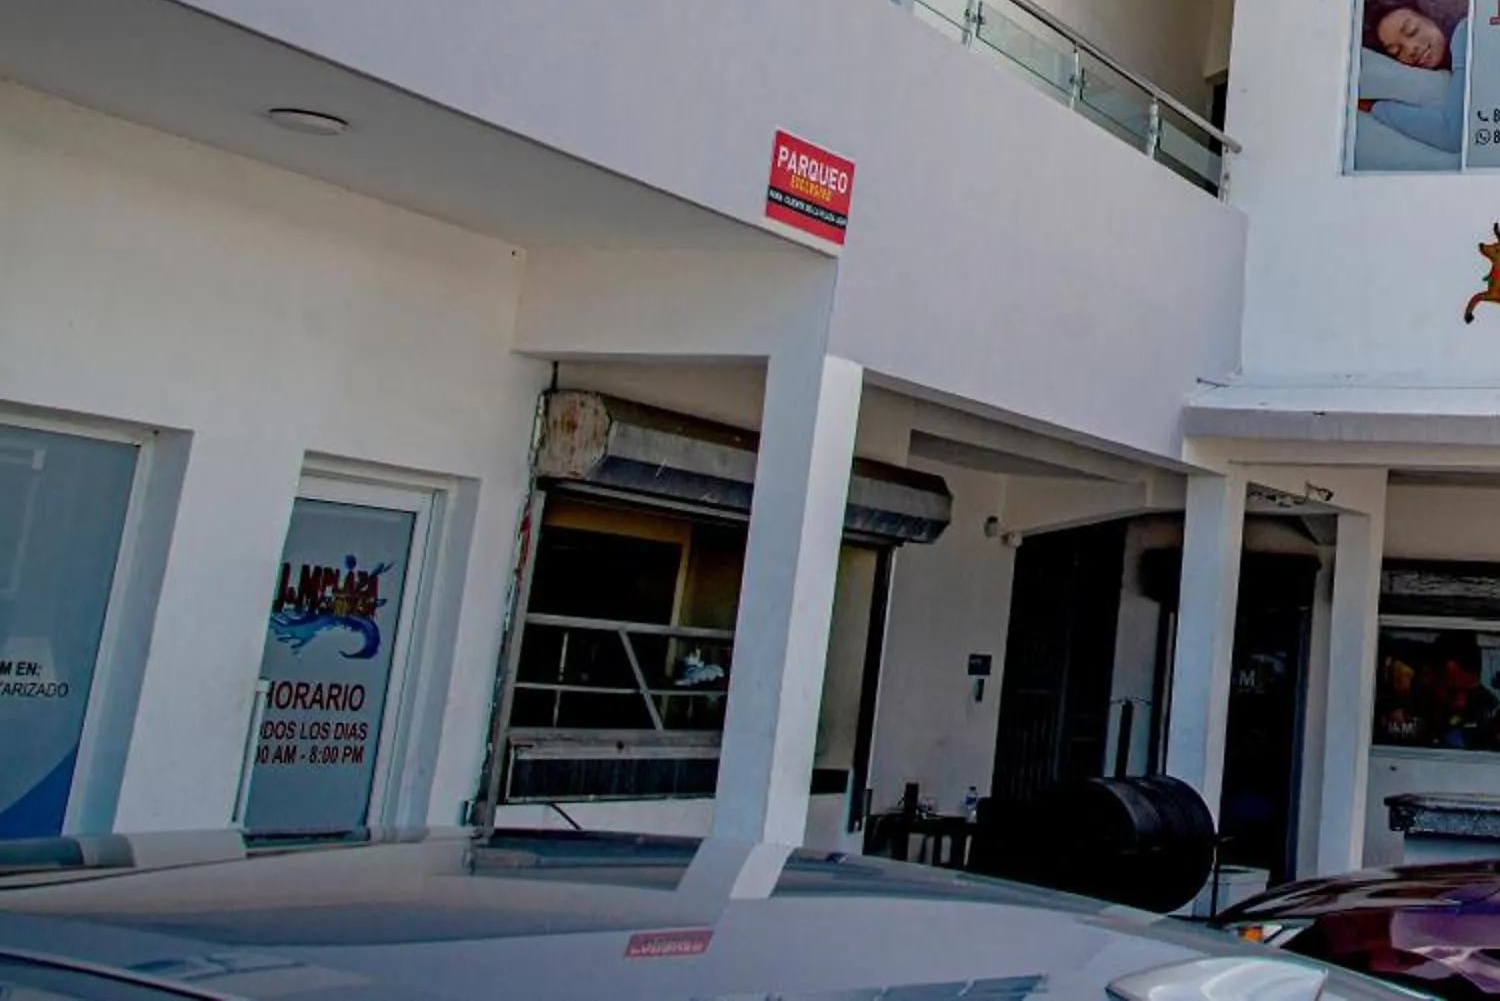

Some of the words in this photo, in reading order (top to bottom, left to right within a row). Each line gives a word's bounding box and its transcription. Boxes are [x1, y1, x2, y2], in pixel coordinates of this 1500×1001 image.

[777, 146, 848, 194] PARQUEO
[300, 722, 331, 740] LOS
[272, 744, 297, 764] AM
[342, 746, 365, 764] PM
